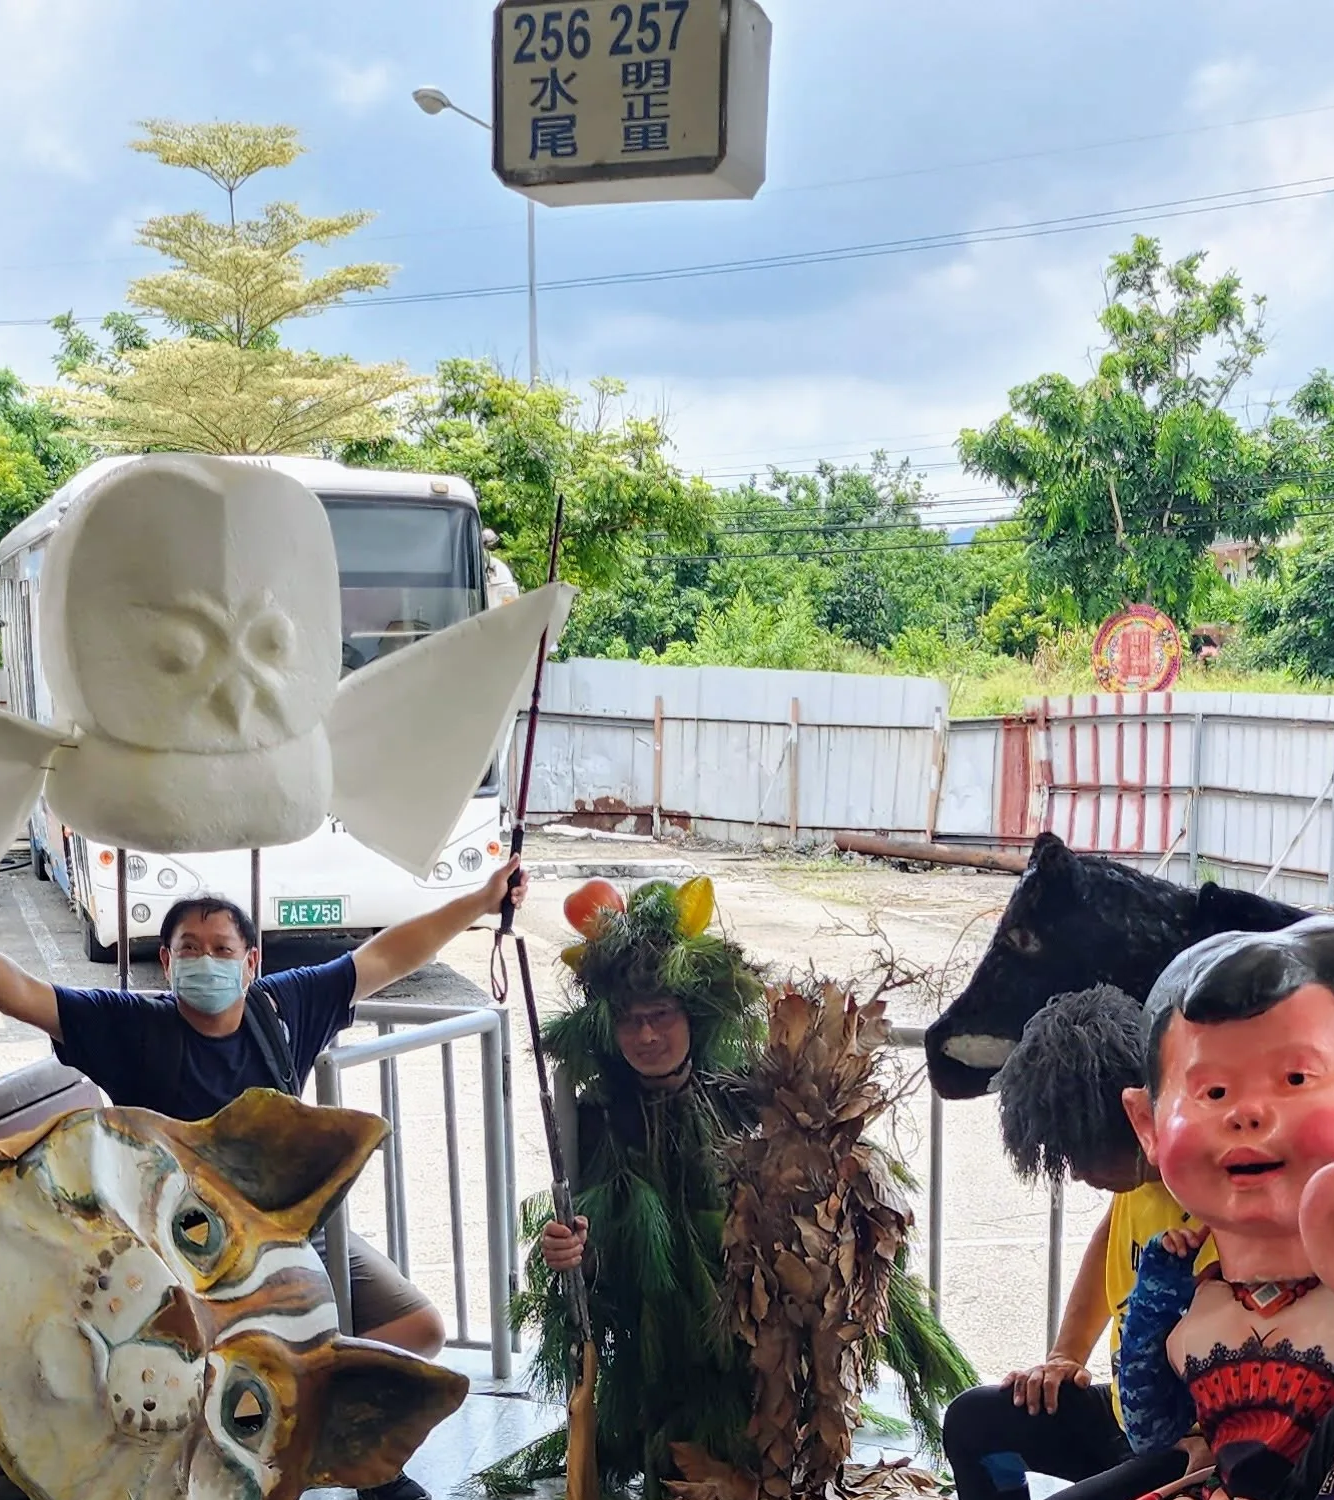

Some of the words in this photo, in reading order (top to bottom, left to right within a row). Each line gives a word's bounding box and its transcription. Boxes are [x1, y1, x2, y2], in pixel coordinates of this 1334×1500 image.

[513, 8, 591, 64] 256
[609, 0, 689, 56] 257
[528, 67, 578, 160] 水尾
[621, 59, 671, 153] 明正里
